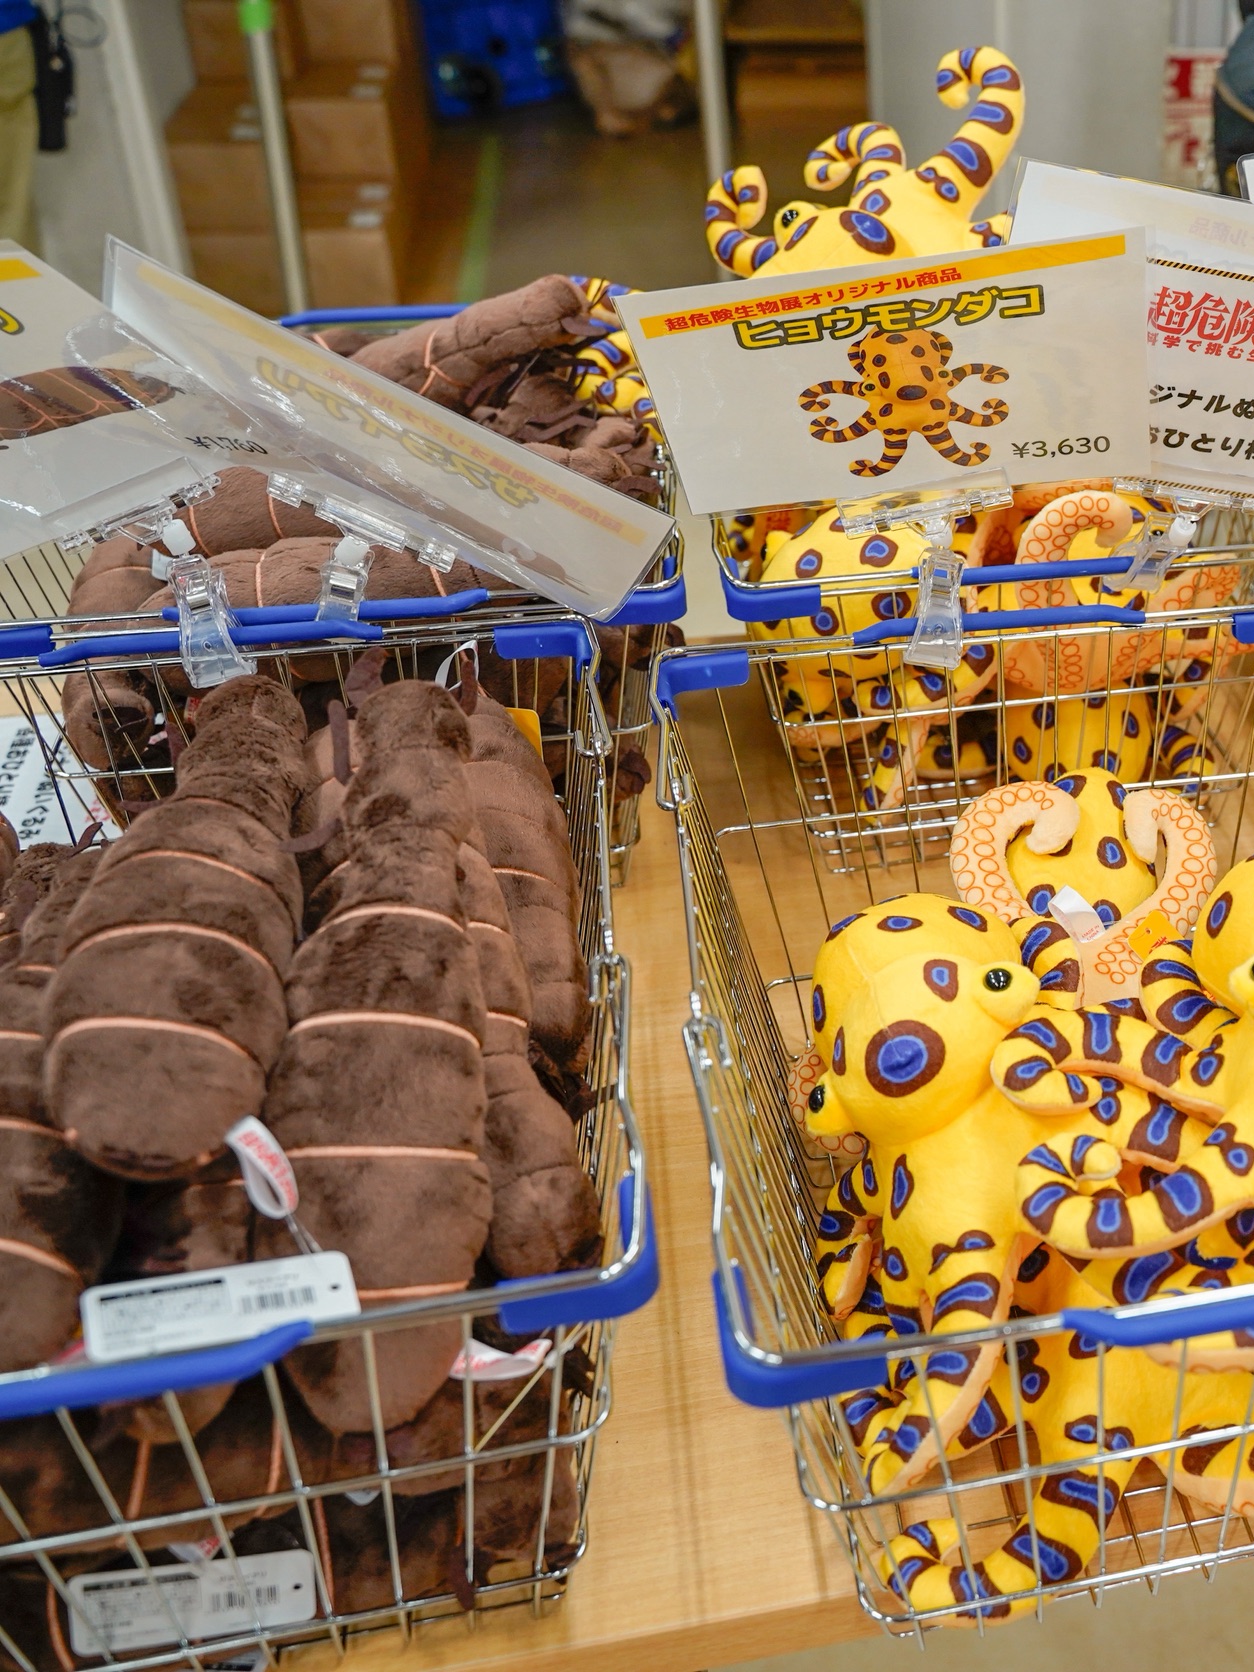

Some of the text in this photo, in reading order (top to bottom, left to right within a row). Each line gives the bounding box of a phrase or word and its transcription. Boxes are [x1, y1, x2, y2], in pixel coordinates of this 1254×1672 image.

[664, 266, 963, 332] 超危険生物展オリジナル商品
[733, 283, 1044, 350] ヒョウモンダコ
[1011, 435, 1111, 459] ¥3,630
